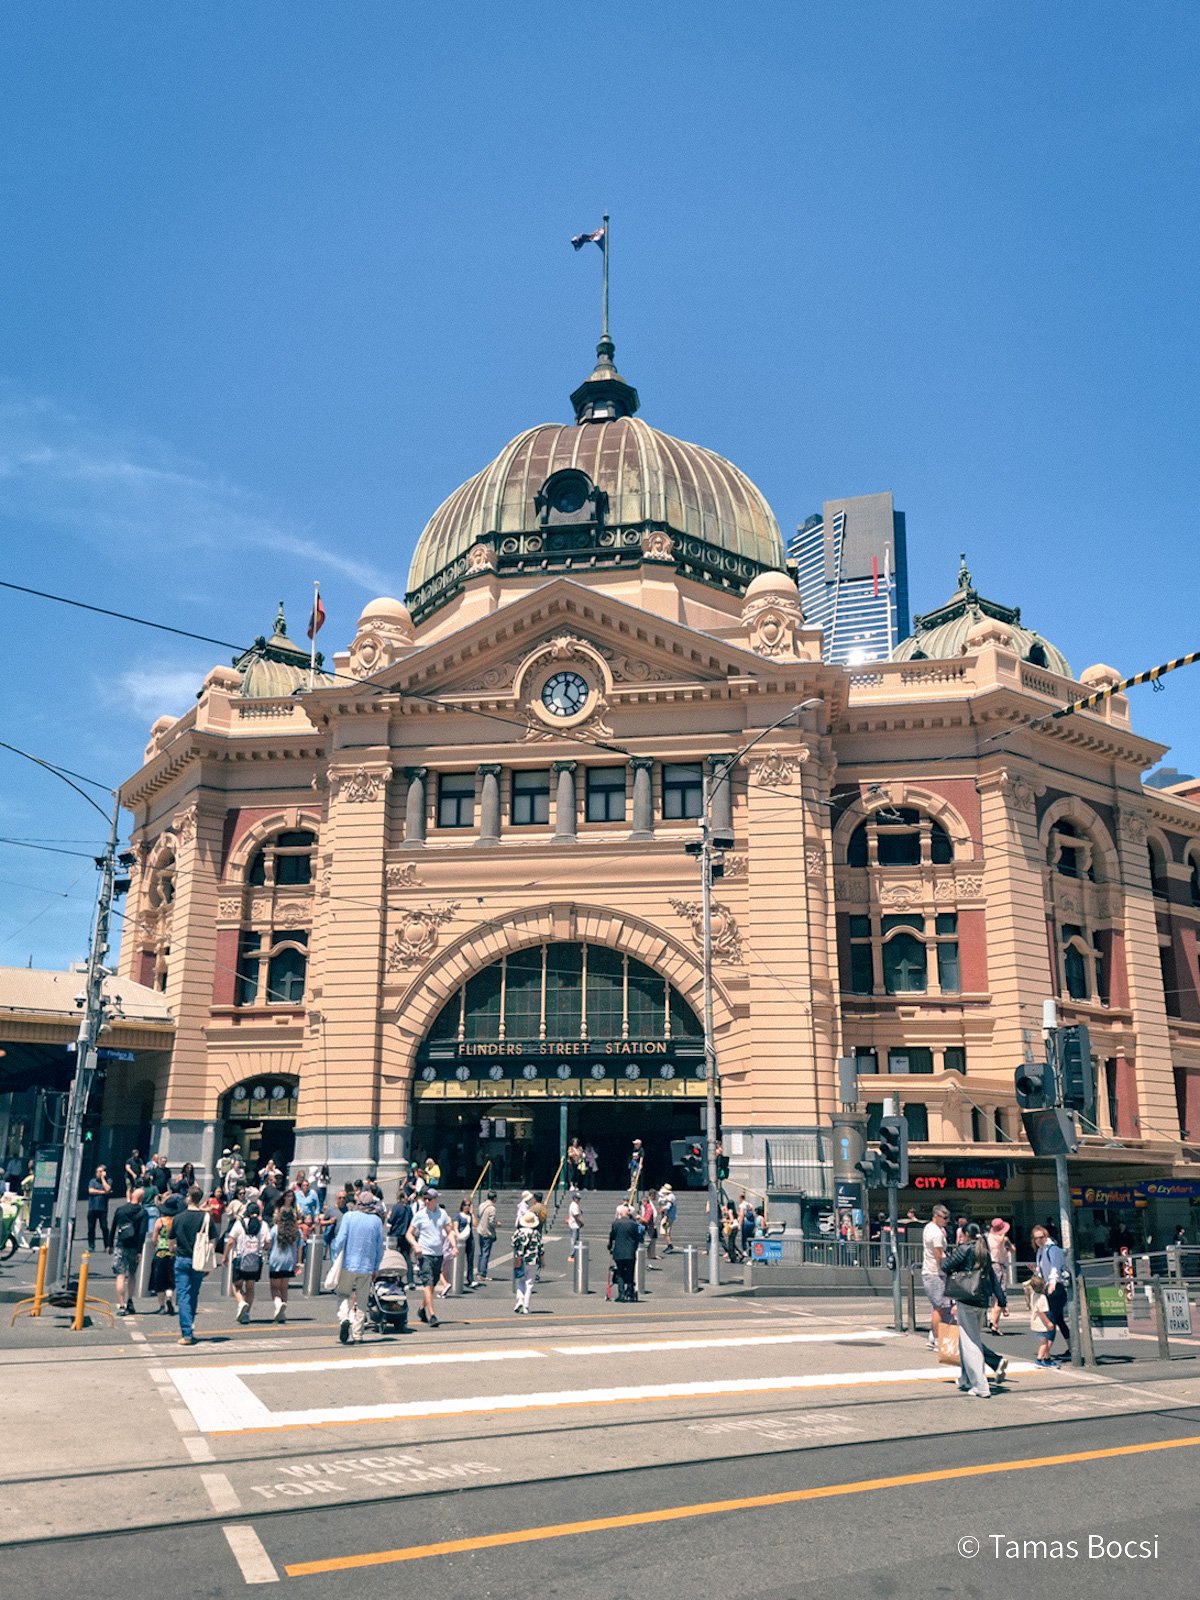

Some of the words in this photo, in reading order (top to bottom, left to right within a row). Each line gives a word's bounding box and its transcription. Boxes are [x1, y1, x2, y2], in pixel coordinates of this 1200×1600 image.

[458, 1043, 522, 1056] FLINDERS
[539, 1042, 590, 1055] STREET
[605, 1041, 667, 1055] STATION
[914, 1176, 947, 1189] CITY
[956, 1177, 1001, 1189] HATTERS
[1157, 1184, 1193, 1195] EzyMart
[1095, 1189, 1131, 1205] EzyMart
[1167, 1292, 1185, 1303] WATCH
[1172, 1306, 1183, 1317] FOR
[276, 1454, 425, 1479] WATCH
[250, 1479, 348, 1499] FOR
[352, 1460, 502, 1487] TRAMS
